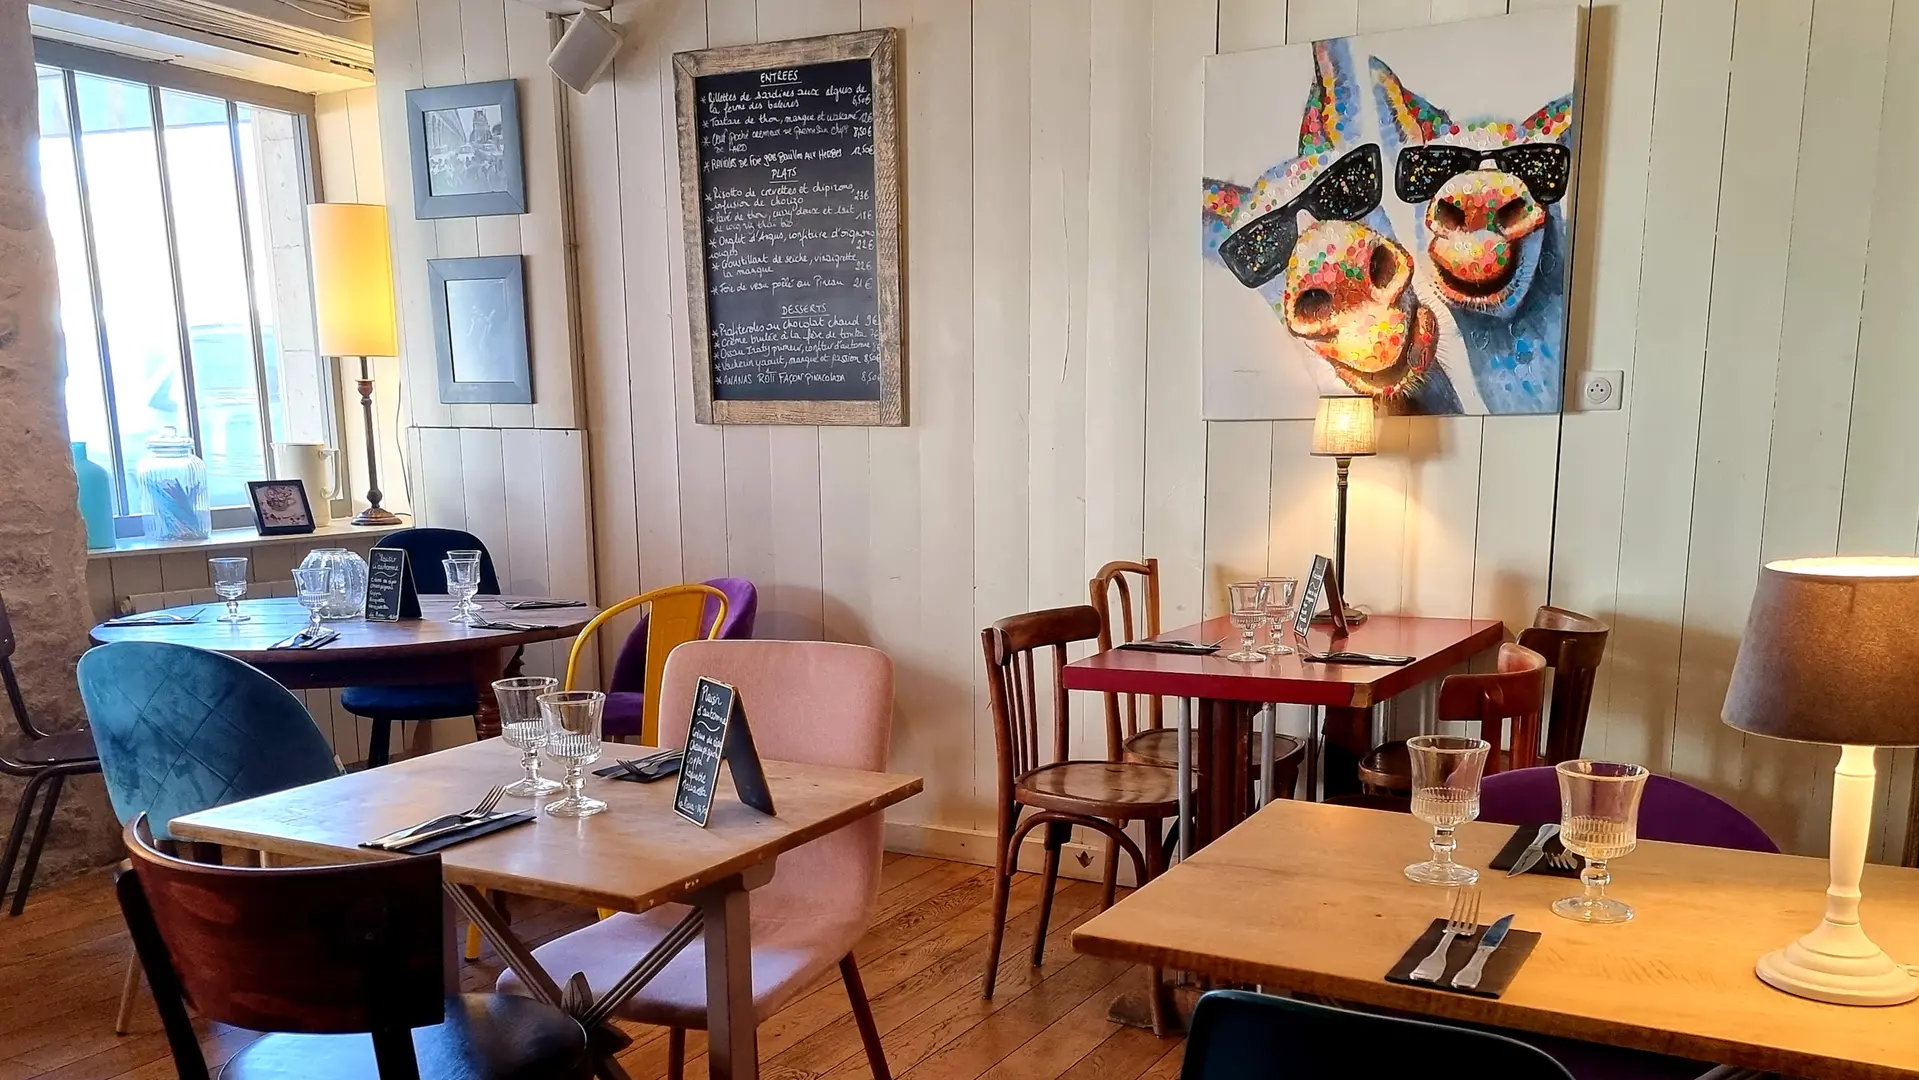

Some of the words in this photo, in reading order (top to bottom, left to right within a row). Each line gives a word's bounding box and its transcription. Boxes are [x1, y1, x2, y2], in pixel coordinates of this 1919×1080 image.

[760, 70, 798, 83] ENTREES
[740, 92, 751, 102] de
[755, 86, 794, 100] sardines
[797, 88, 820, 96] aux
[826, 85, 852, 102] algues
[856, 84, 867, 94] de
[709, 104, 720, 114] la
[750, 101, 762, 110] des
[710, 117, 741, 127] Tartare
[744, 116, 756, 124] de
[784, 114, 815, 126] mangue
[818, 112, 826, 122] et
[771, 167, 798, 180] PLATS
[713, 187, 742, 200] Risotto
[745, 187, 756, 197] de
[798, 182, 809, 194] et
[754, 198, 766, 207] de
[822, 206, 832, 214] et
[772, 254, 783, 264] de
[723, 270, 733, 278] la
[737, 282, 748, 292] de
[796, 280, 811, 288] au
[781, 303, 828, 316] DESSERTS
[766, 322, 780, 331] au
[783, 316, 824, 330] chocolat
[828, 314, 860, 328] chaud
[790, 330, 801, 340] la
[826, 330, 837, 338] de
[723, 374, 752, 386] ANANAS
